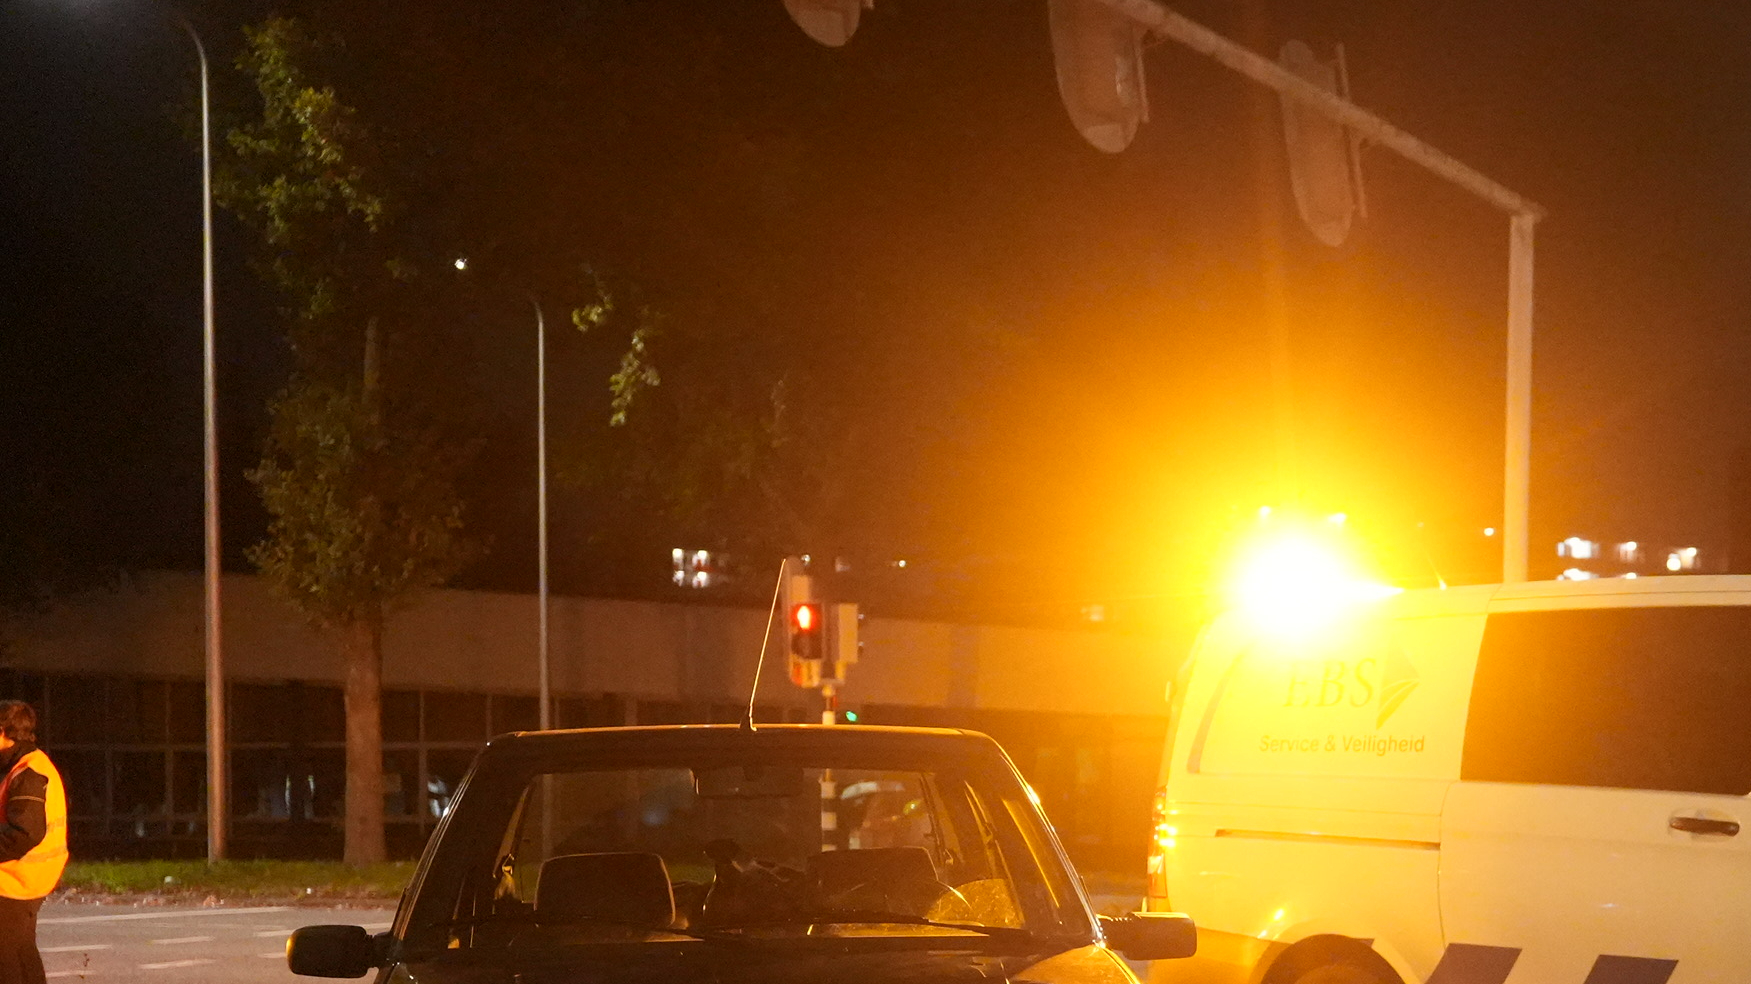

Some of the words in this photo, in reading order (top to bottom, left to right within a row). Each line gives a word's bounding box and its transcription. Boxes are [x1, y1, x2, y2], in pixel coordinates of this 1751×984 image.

[1259, 735, 1319, 752] Service
[1324, 735, 1336, 752] &
[1342, 735, 1425, 757] Veiligheid
